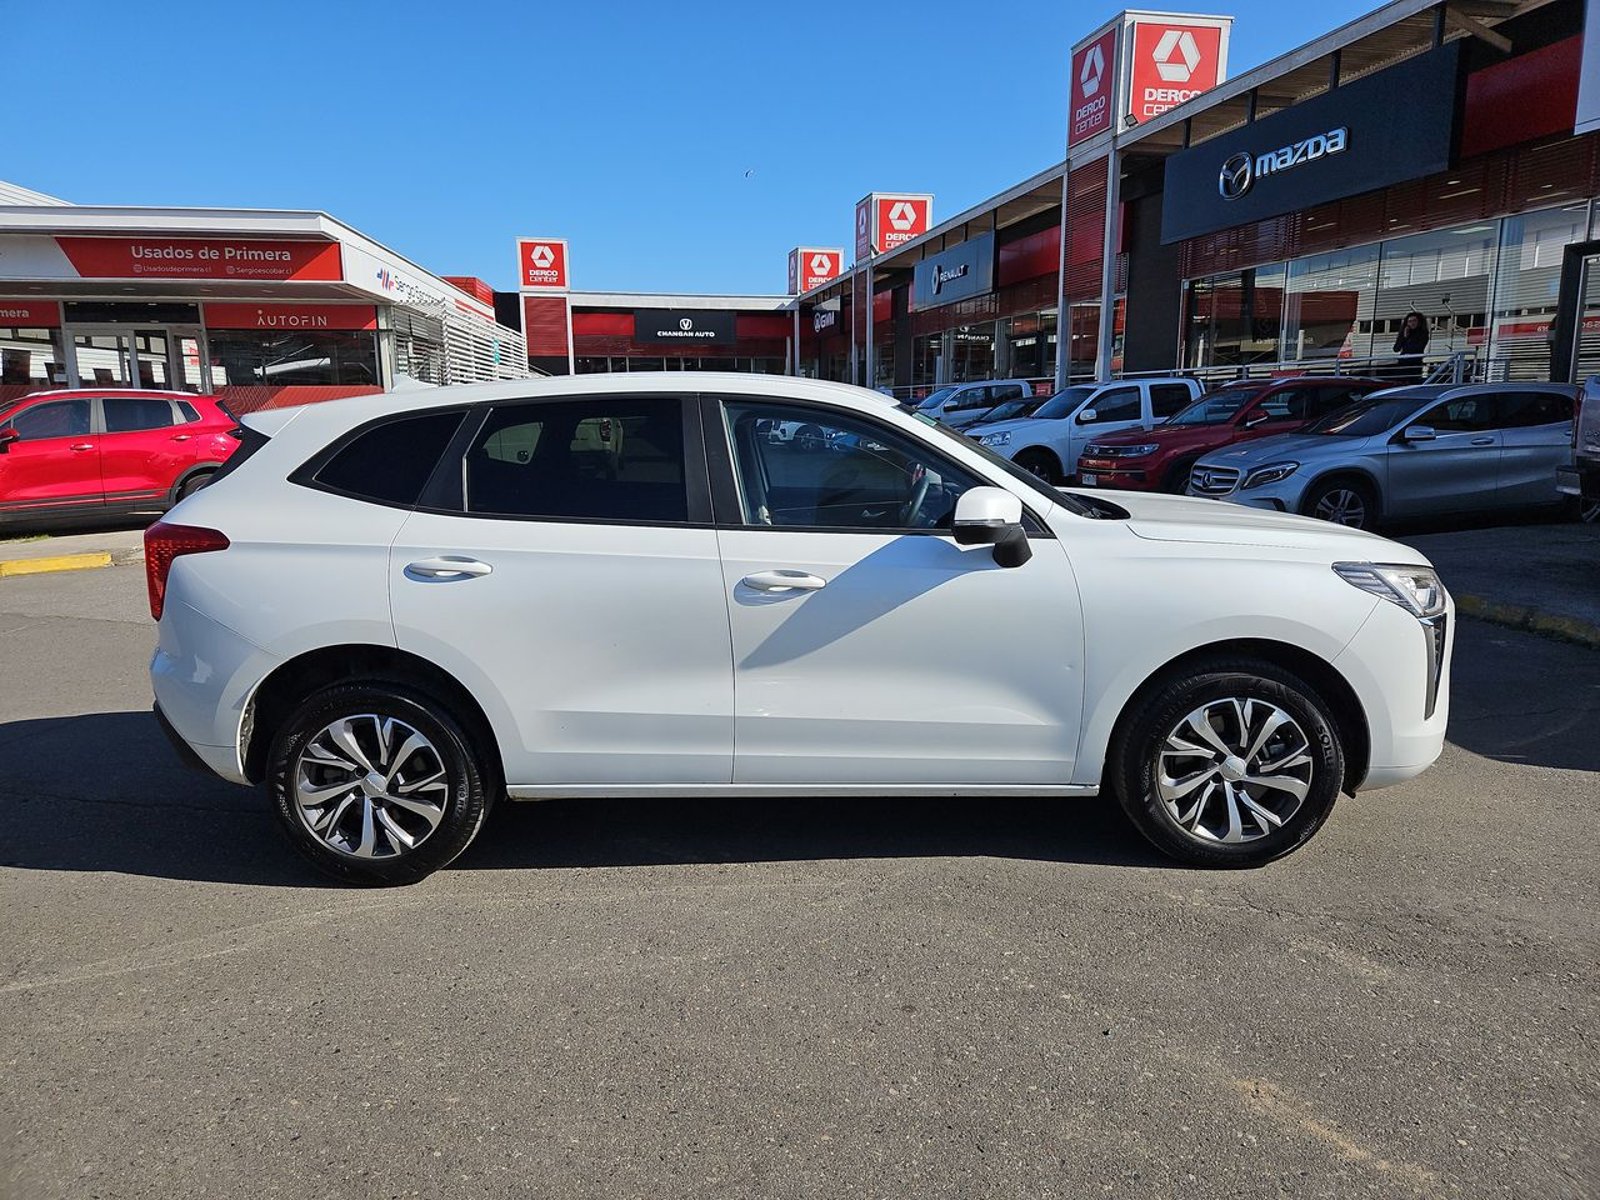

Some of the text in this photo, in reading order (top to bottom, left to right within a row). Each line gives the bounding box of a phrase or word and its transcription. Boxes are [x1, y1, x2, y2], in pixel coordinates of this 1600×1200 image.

[1076, 95, 1106, 121] DERCO
[1075, 110, 1105, 135] center
[131, 246, 291, 261] Usados de Primera
[257, 309, 328, 327] AUTOFIN
[656, 330, 694, 338] CHANGAN
